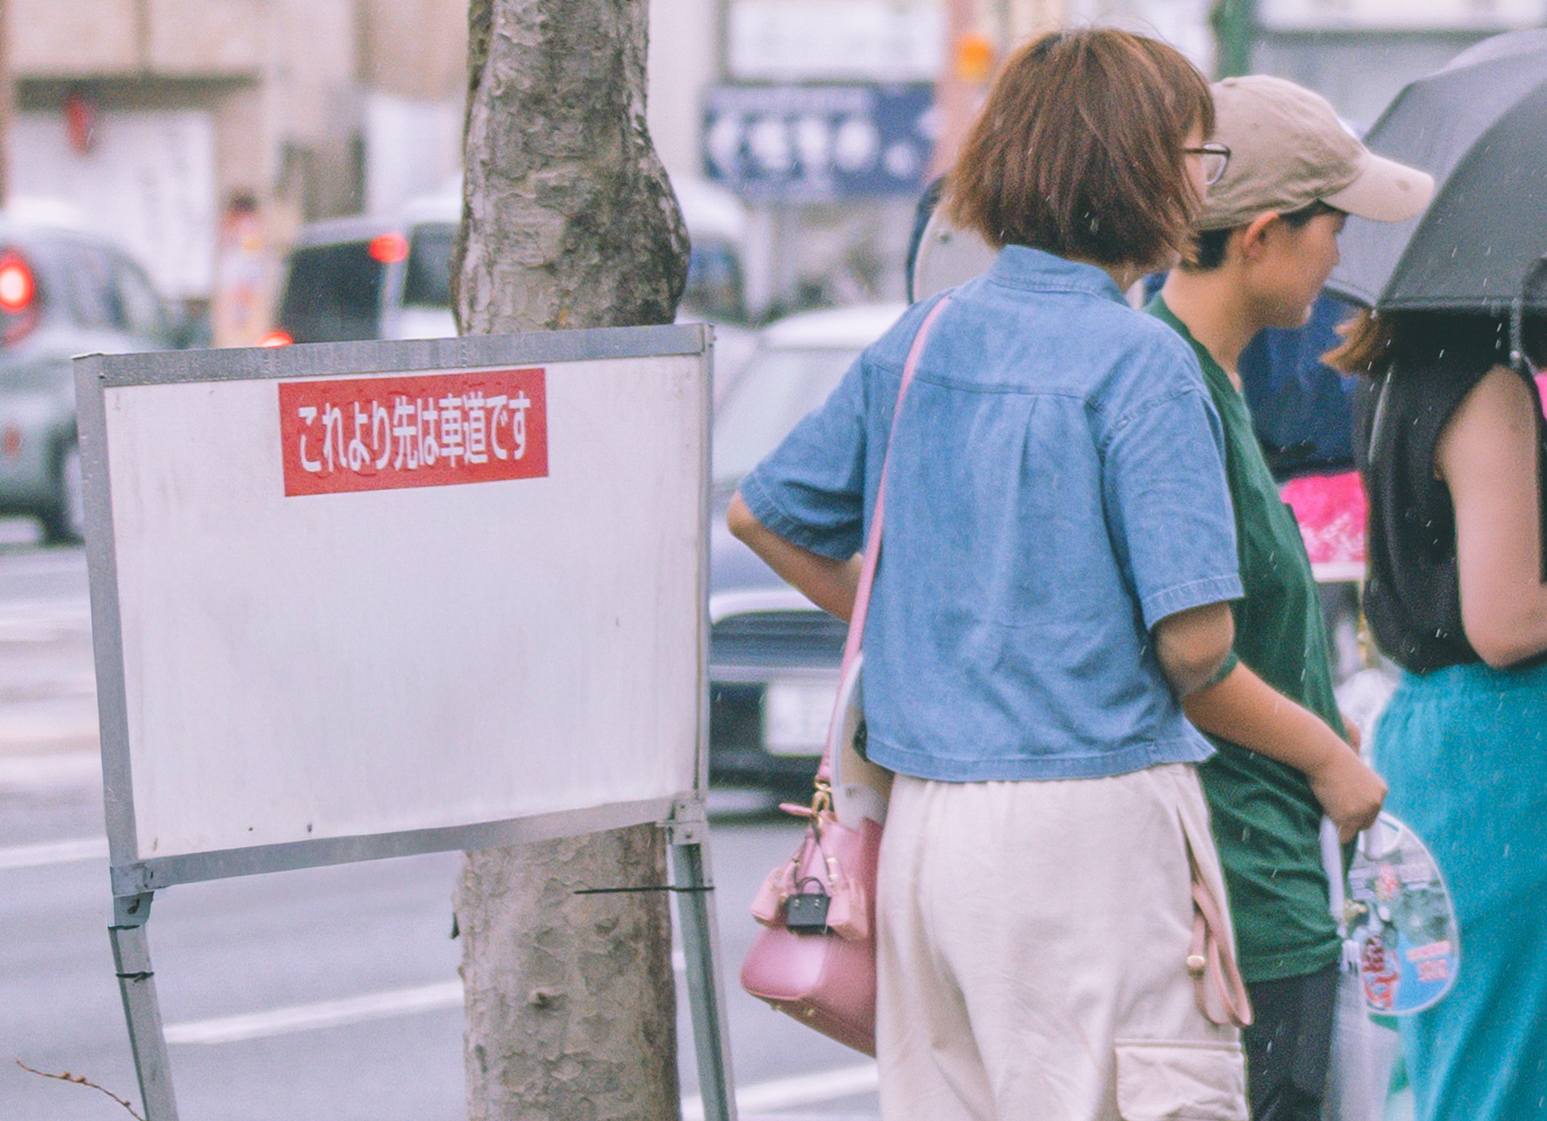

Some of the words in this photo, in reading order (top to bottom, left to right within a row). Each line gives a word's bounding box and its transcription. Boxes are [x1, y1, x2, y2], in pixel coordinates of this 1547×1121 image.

[298, 390, 532, 473] これより先は車道です
